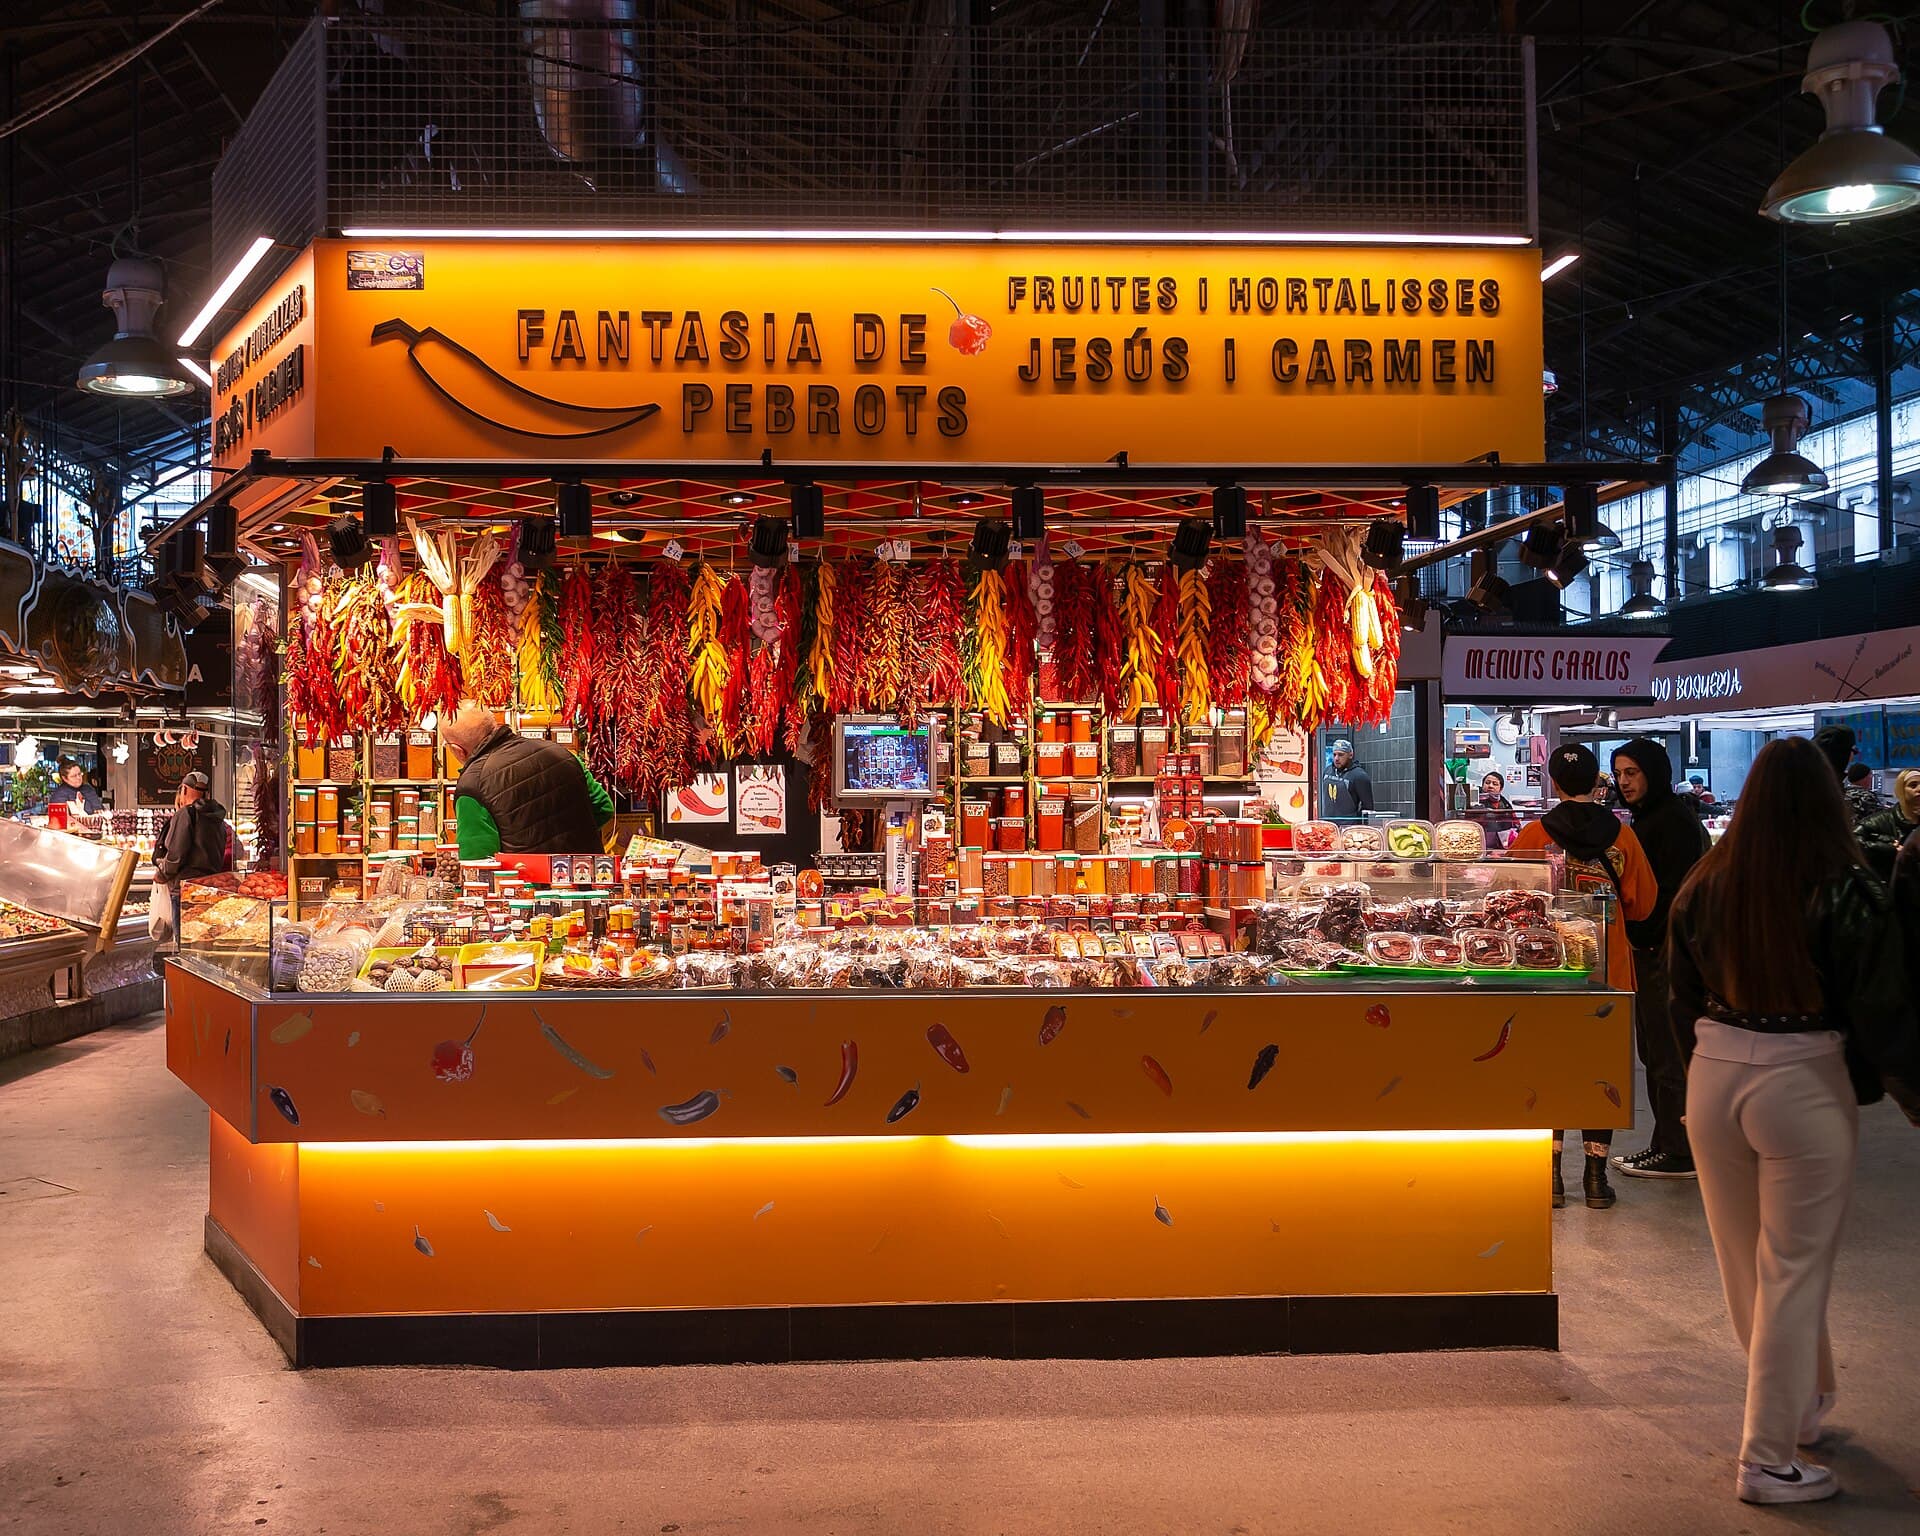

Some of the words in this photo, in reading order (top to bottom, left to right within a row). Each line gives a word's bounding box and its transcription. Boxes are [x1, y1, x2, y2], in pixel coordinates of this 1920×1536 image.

[1008, 275, 1179, 312] FRUITES
[1199, 276, 1209, 312] I
[1229, 277, 1500, 314] HORTALISSES
[251, 284, 303, 362] HORTALIZAS
[517, 308, 822, 364] FANTASIA
[852, 312, 927, 364] DE
[1017, 326, 1190, 383] JESÚS
[1224, 337, 1236, 383] I
[1271, 337, 1495, 383] CARMEN
[256, 344, 304, 423] CARMEN
[682, 382, 968, 437] PEBROTS
[1464, 648, 1545, 681] MENUTS
[1551, 649, 1631, 682] CARLOS
[1618, 684, 1638, 695] 657
